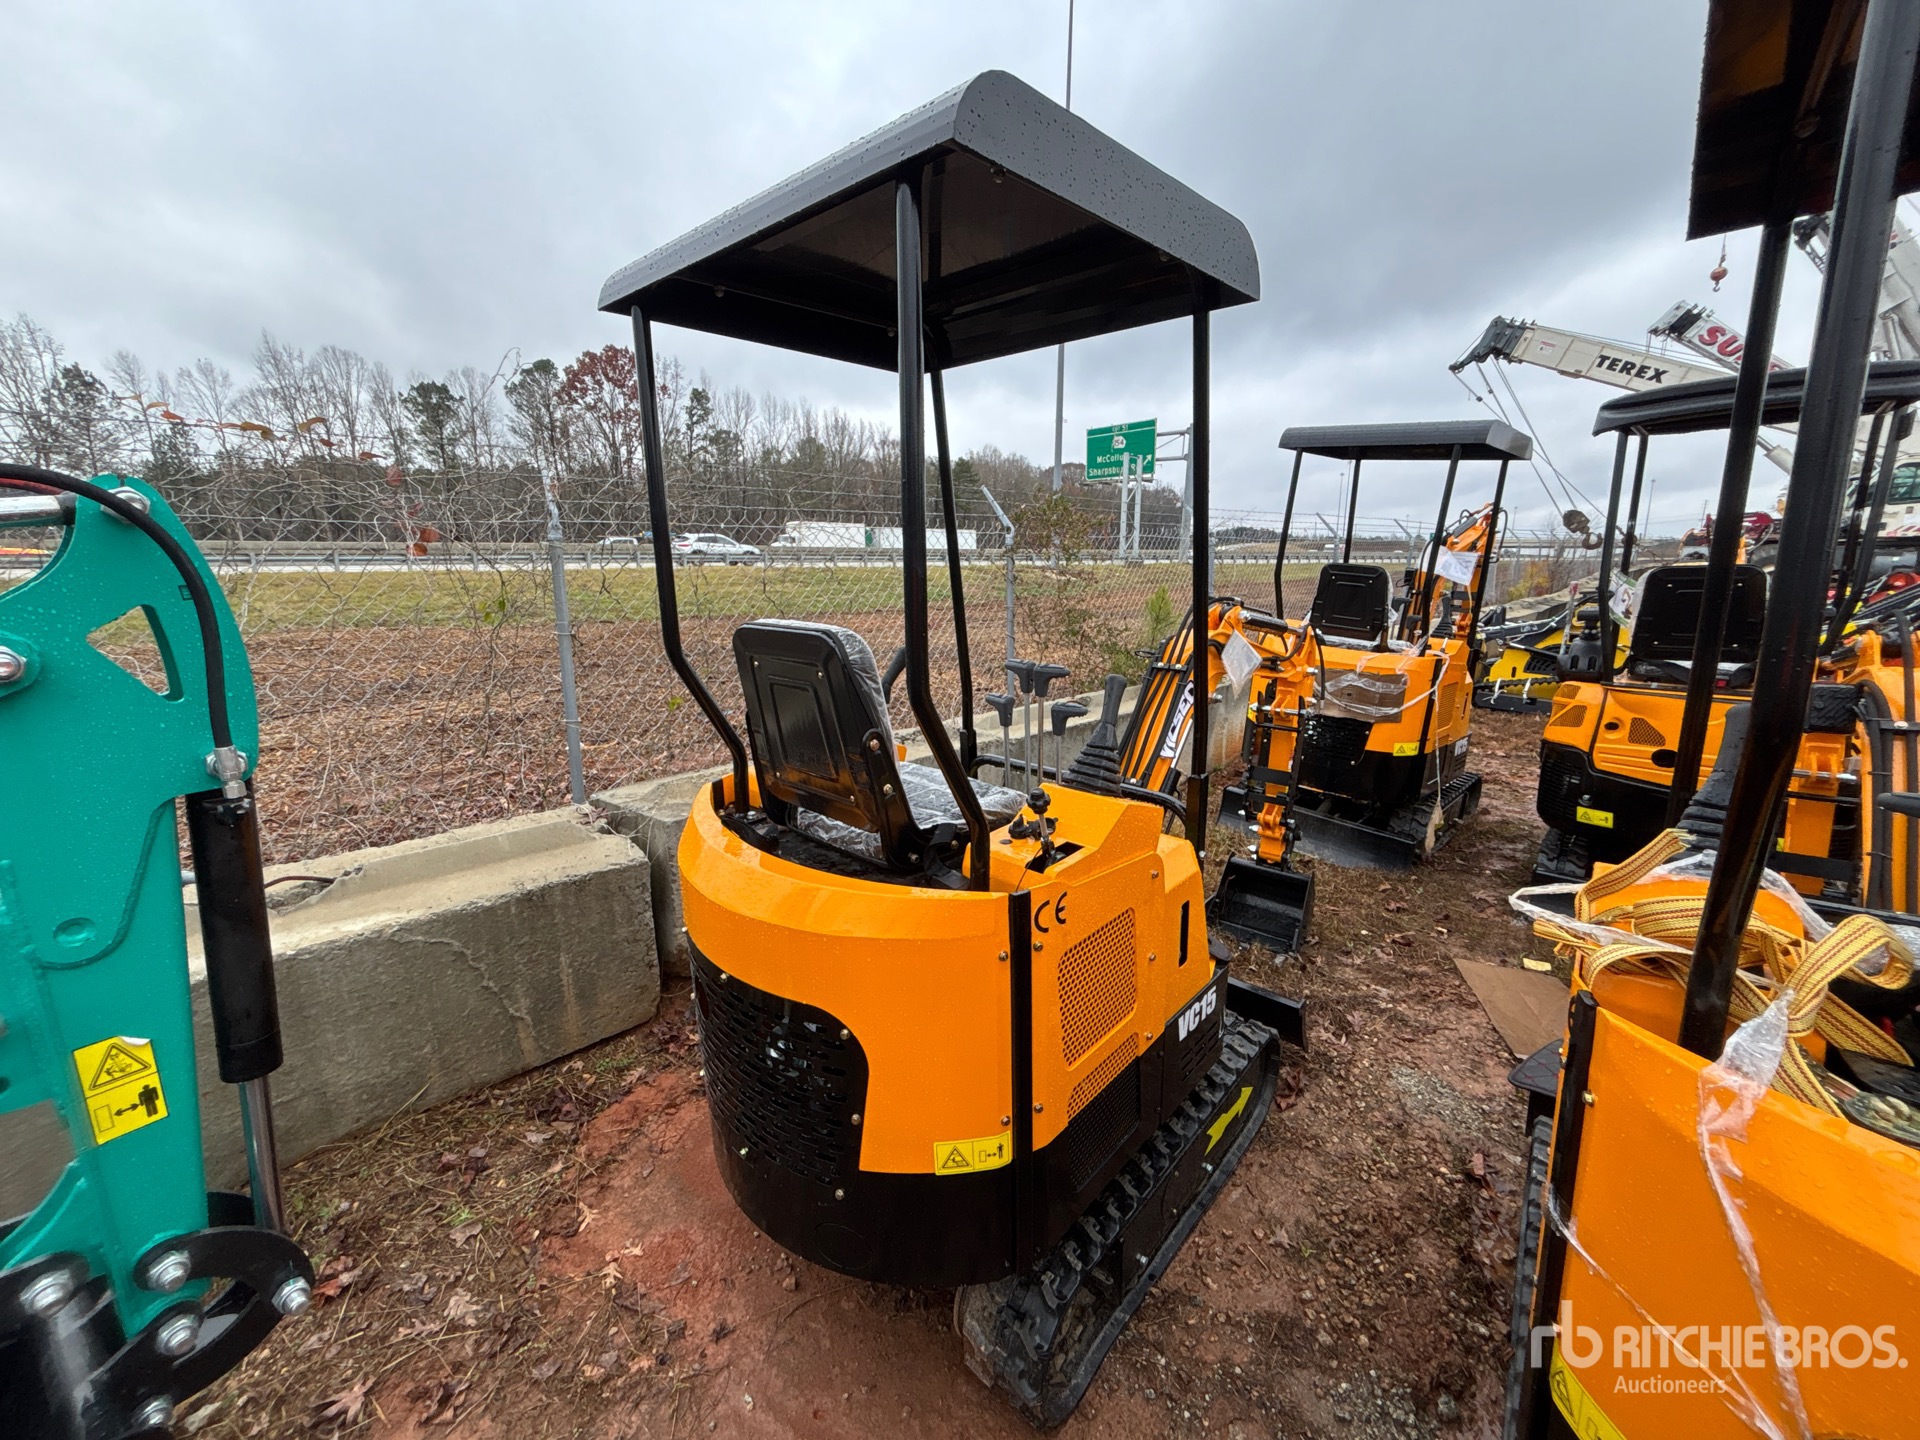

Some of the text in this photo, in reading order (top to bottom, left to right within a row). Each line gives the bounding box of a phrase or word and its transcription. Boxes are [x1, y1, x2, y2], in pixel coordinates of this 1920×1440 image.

[1698, 325, 1744, 365] SU
[1596, 354, 1670, 384] TEREX
[1097, 454, 1124, 464] McCollu
[1034, 891, 1067, 933] CE
[1178, 985, 1217, 1042] VC15
